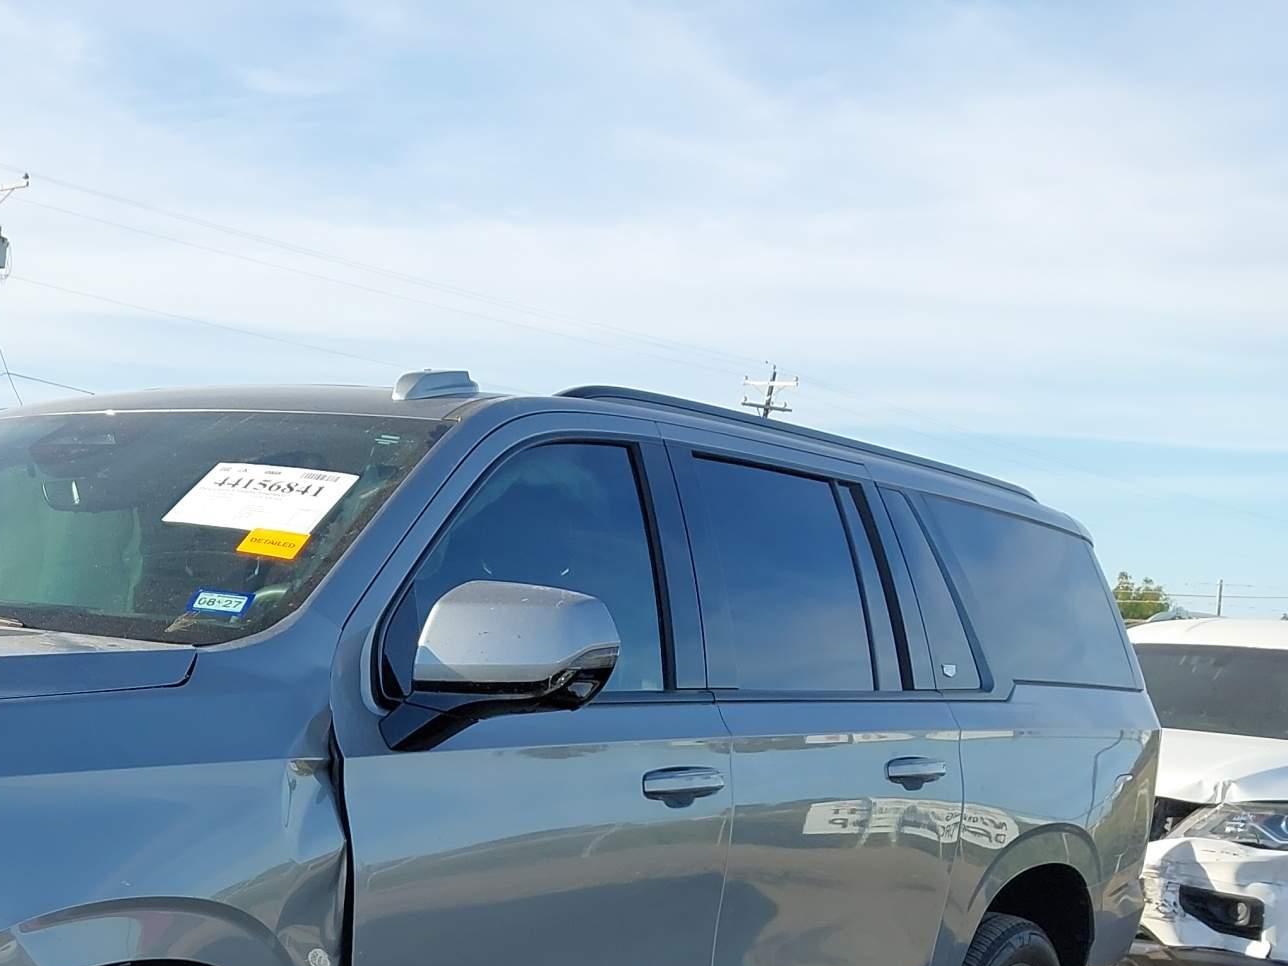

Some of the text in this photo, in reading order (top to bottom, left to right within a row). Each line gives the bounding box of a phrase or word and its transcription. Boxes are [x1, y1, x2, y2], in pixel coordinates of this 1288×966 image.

[214, 477, 325, 498] 44156841
[249, 536, 297, 550] DETAILED
[198, 597, 242, 608] 08 27
